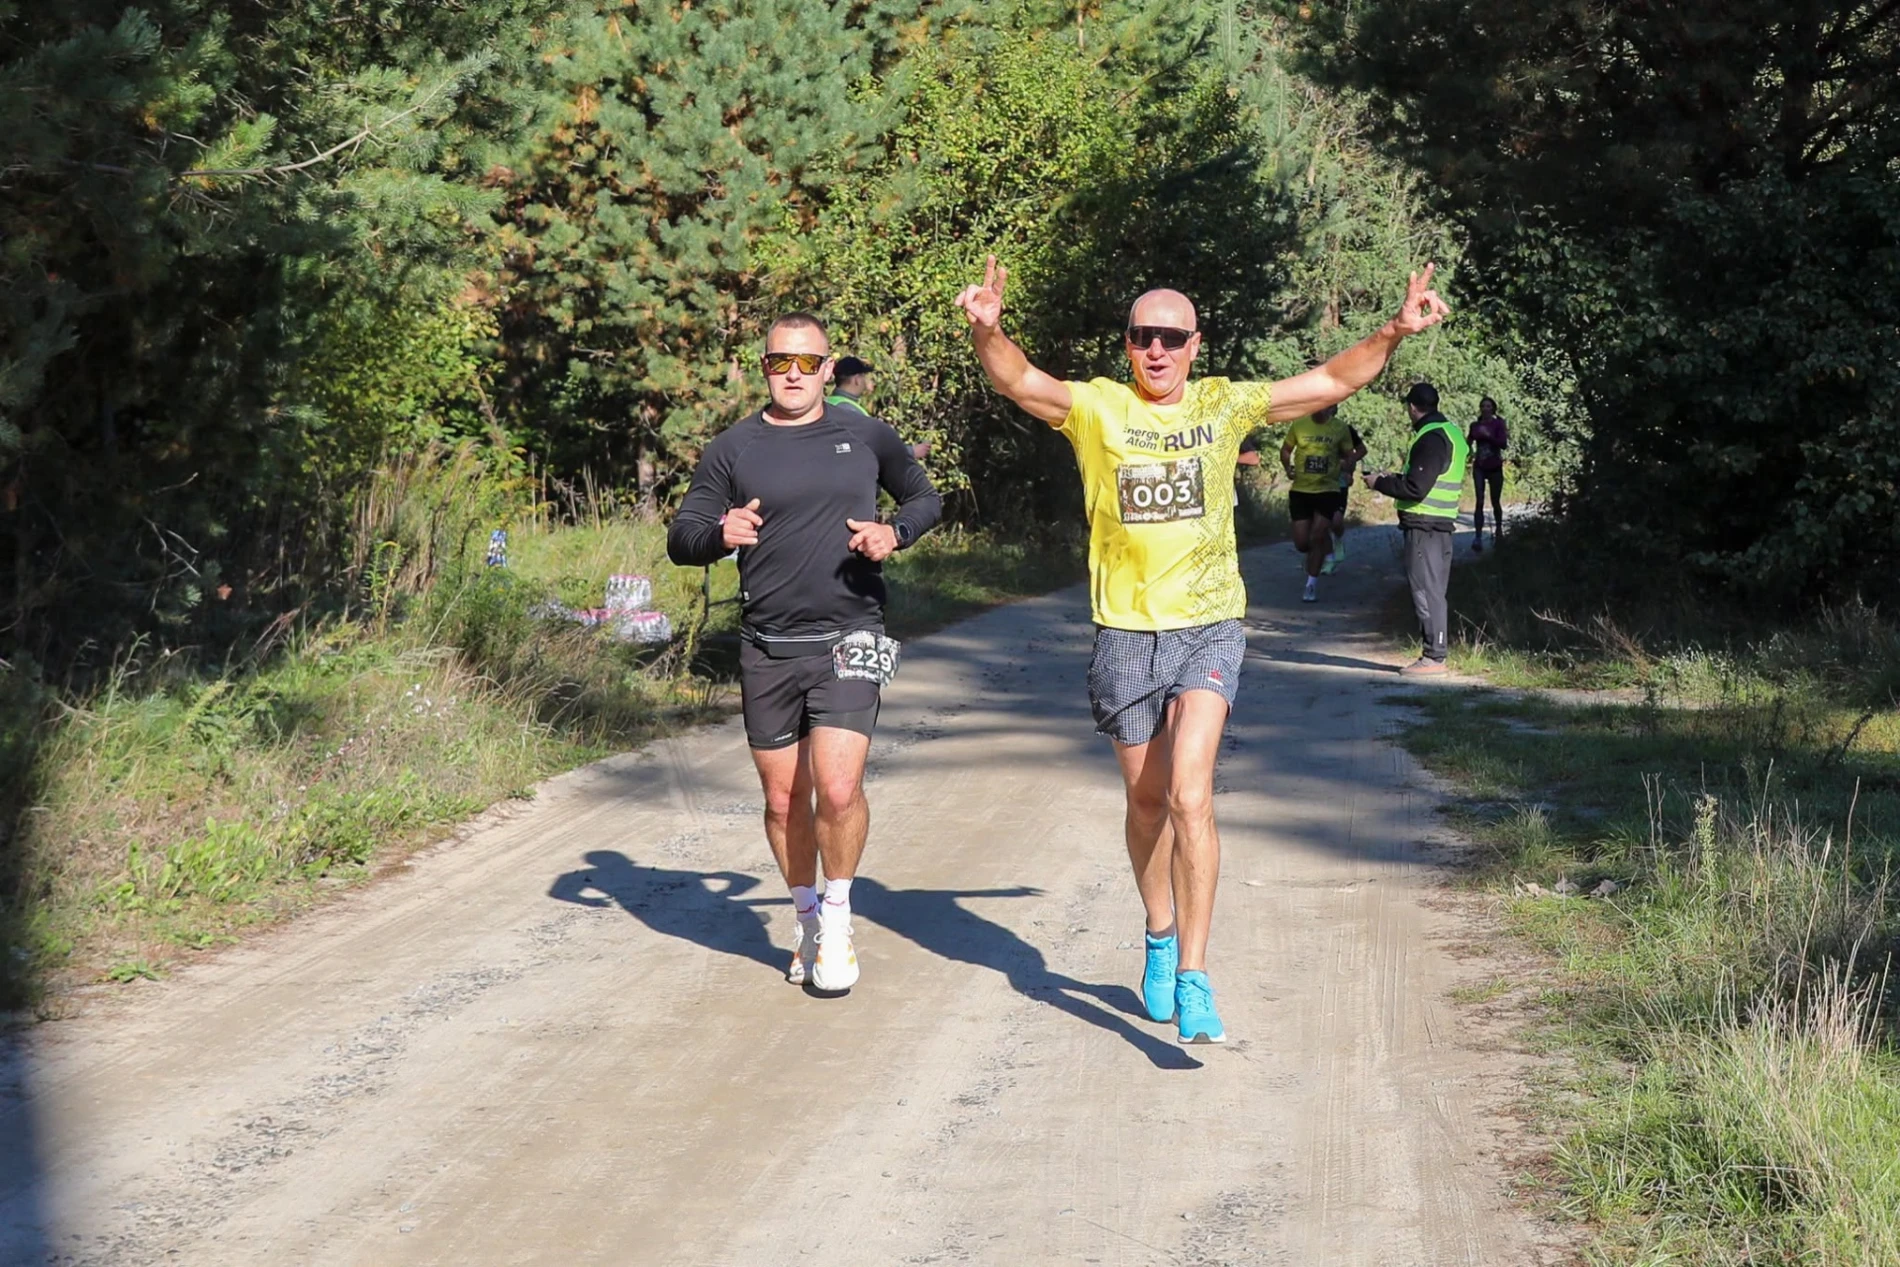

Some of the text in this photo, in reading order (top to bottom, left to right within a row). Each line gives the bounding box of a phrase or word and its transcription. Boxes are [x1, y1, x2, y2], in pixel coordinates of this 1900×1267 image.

[1125, 437, 1157, 451] Atom
[1163, 423, 1213, 452] RUN
[1132, 480, 1191, 507] 003
[850, 648, 892, 673] 229
